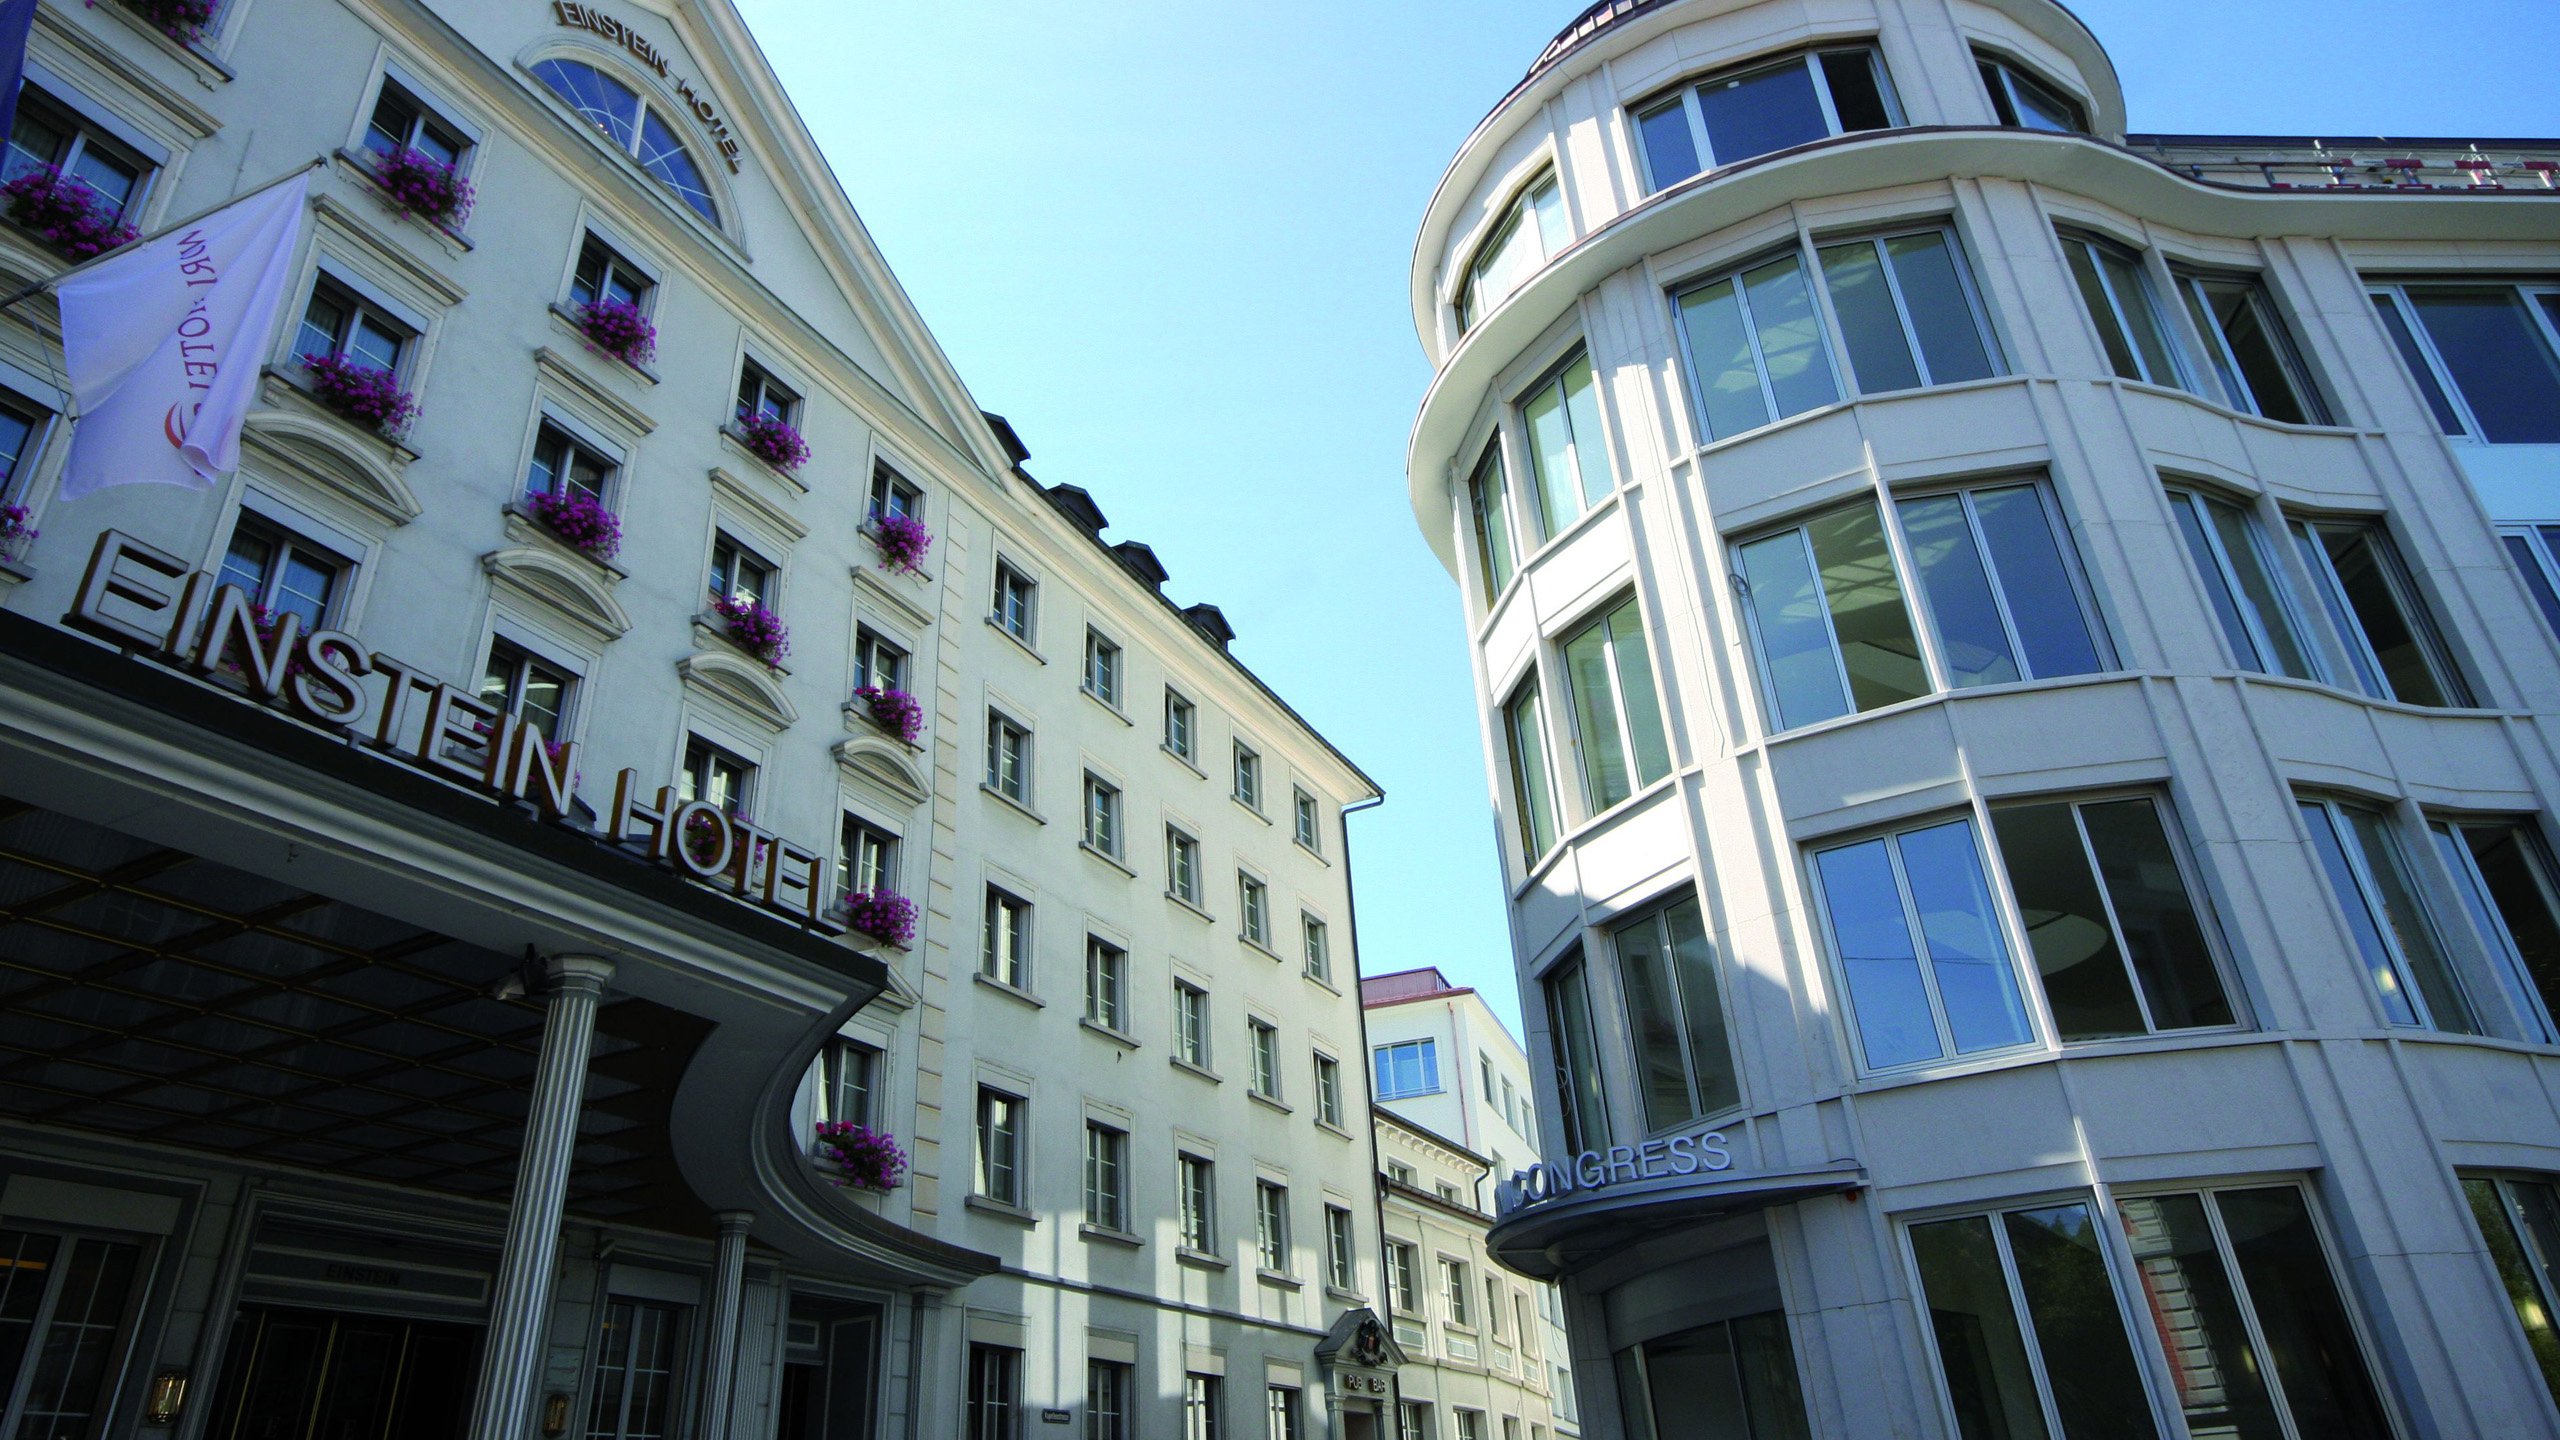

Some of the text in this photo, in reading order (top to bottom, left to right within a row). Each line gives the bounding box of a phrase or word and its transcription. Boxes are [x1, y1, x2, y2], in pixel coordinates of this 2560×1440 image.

[554, 0, 744, 174] EINSTEIN HOTEL
[62, 528, 847, 937] EINSTEIN HOTEL
[1510, 1131, 1732, 1207] CONGRESS
[326, 1263, 401, 1286] EINSTEIN
[1346, 1374, 1386, 1392] PUB BAR
